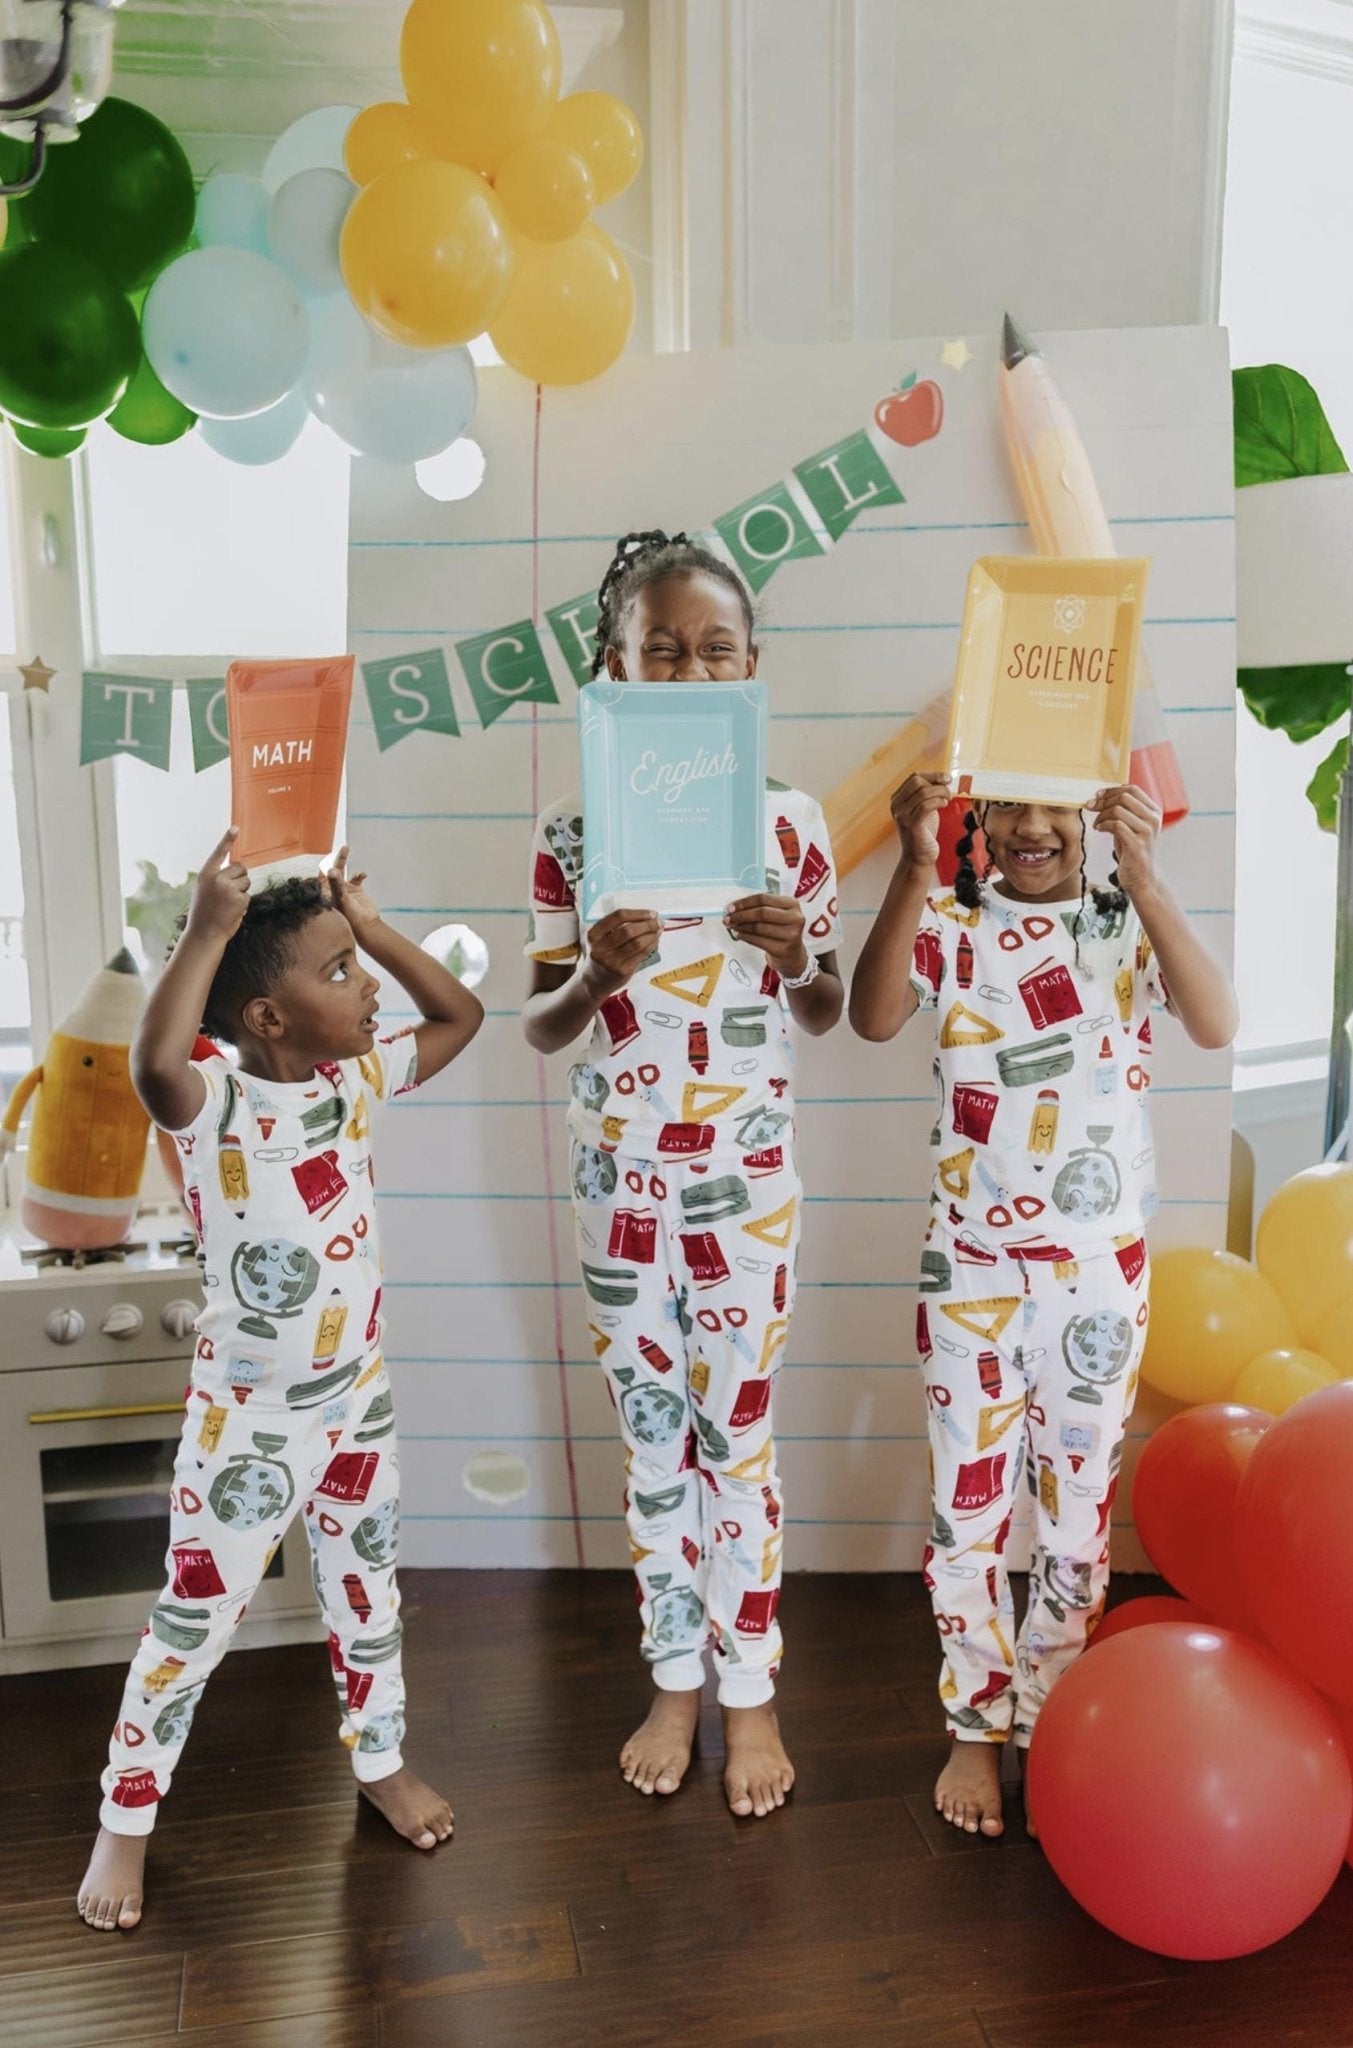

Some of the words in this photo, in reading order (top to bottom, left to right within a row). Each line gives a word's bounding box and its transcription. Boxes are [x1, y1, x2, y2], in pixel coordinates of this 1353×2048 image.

[1007, 642, 1118, 684] SCIENCE
[252, 739, 313, 769] MATH
[630, 741, 738, 803] English
[1038, 971, 1069, 990] MATH
[967, 1094, 995, 1111] MATH
[307, 1187, 330, 1208] MATH
[630, 1221, 655, 1234] MATH
[1124, 1256, 1142, 1278] MATH
[321, 1479, 347, 1494] MAT
[955, 1492, 987, 1506] MATH
[184, 1555, 212, 1567] MATH
[123, 1777, 154, 1791] MATH
